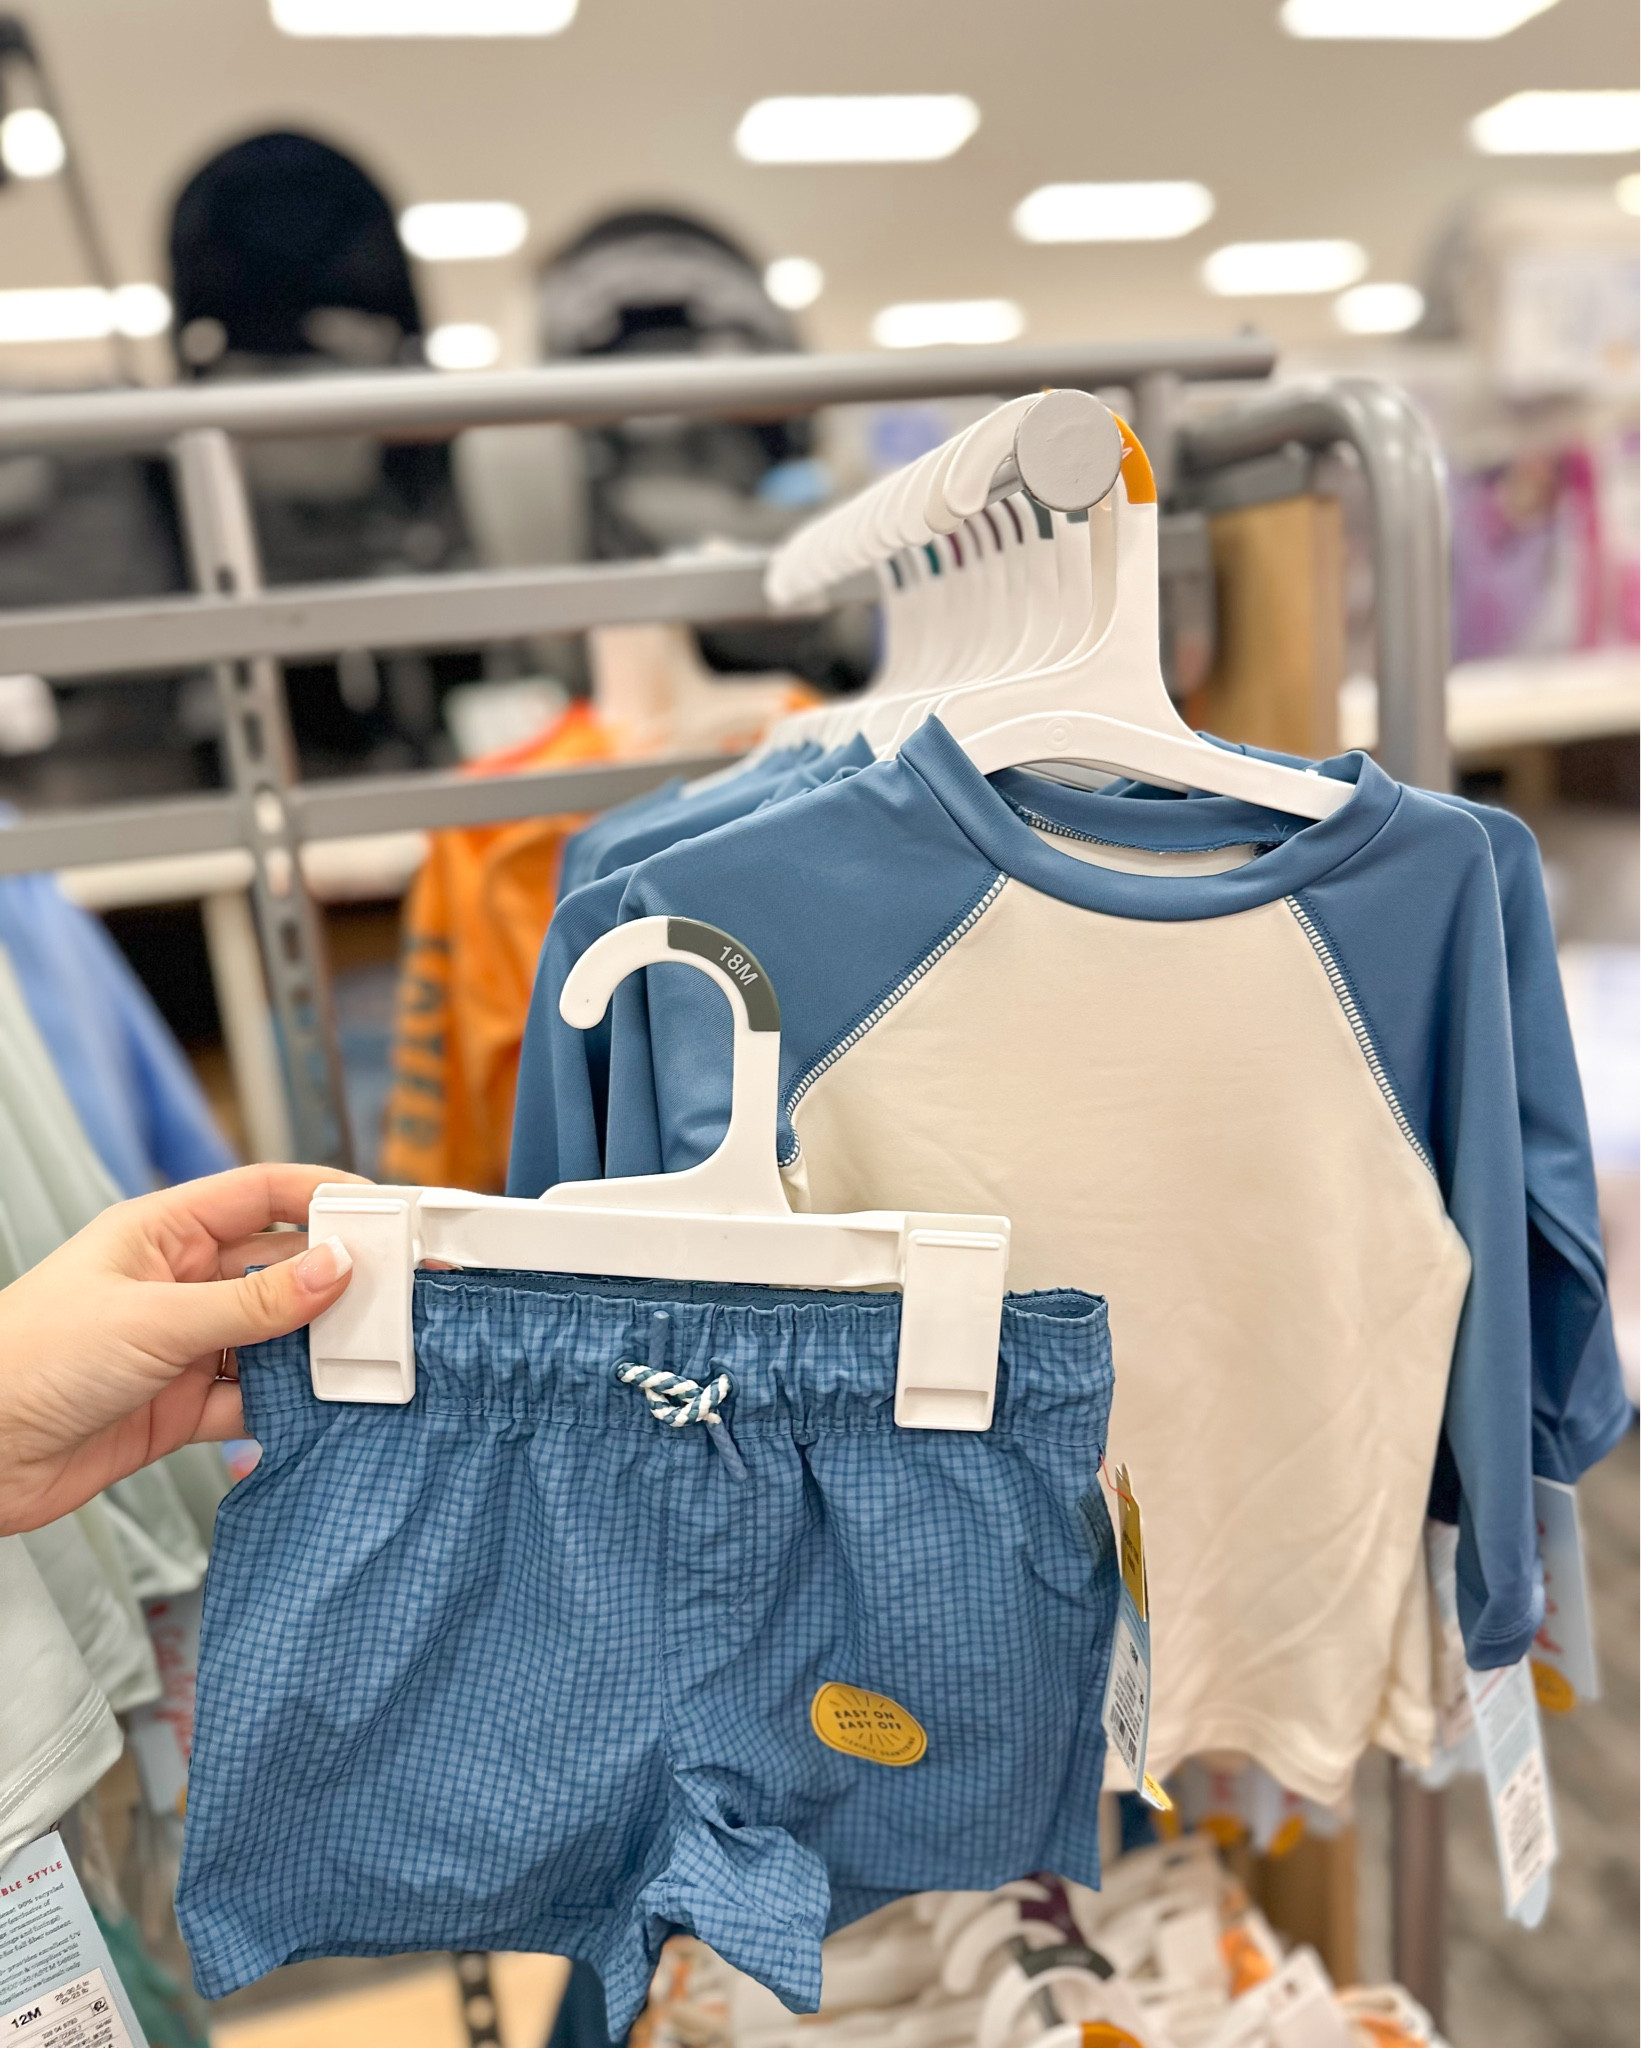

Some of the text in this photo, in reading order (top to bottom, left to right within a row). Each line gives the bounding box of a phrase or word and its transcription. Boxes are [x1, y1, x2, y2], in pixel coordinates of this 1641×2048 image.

[720, 946, 759, 986] 18M
[834, 1710, 895, 1720] EASY ON
[839, 1721, 901, 1731] EASY OFF
[0, 1861, 63, 1896] BLE STYLE
[11, 2006, 42, 2028] 12M
